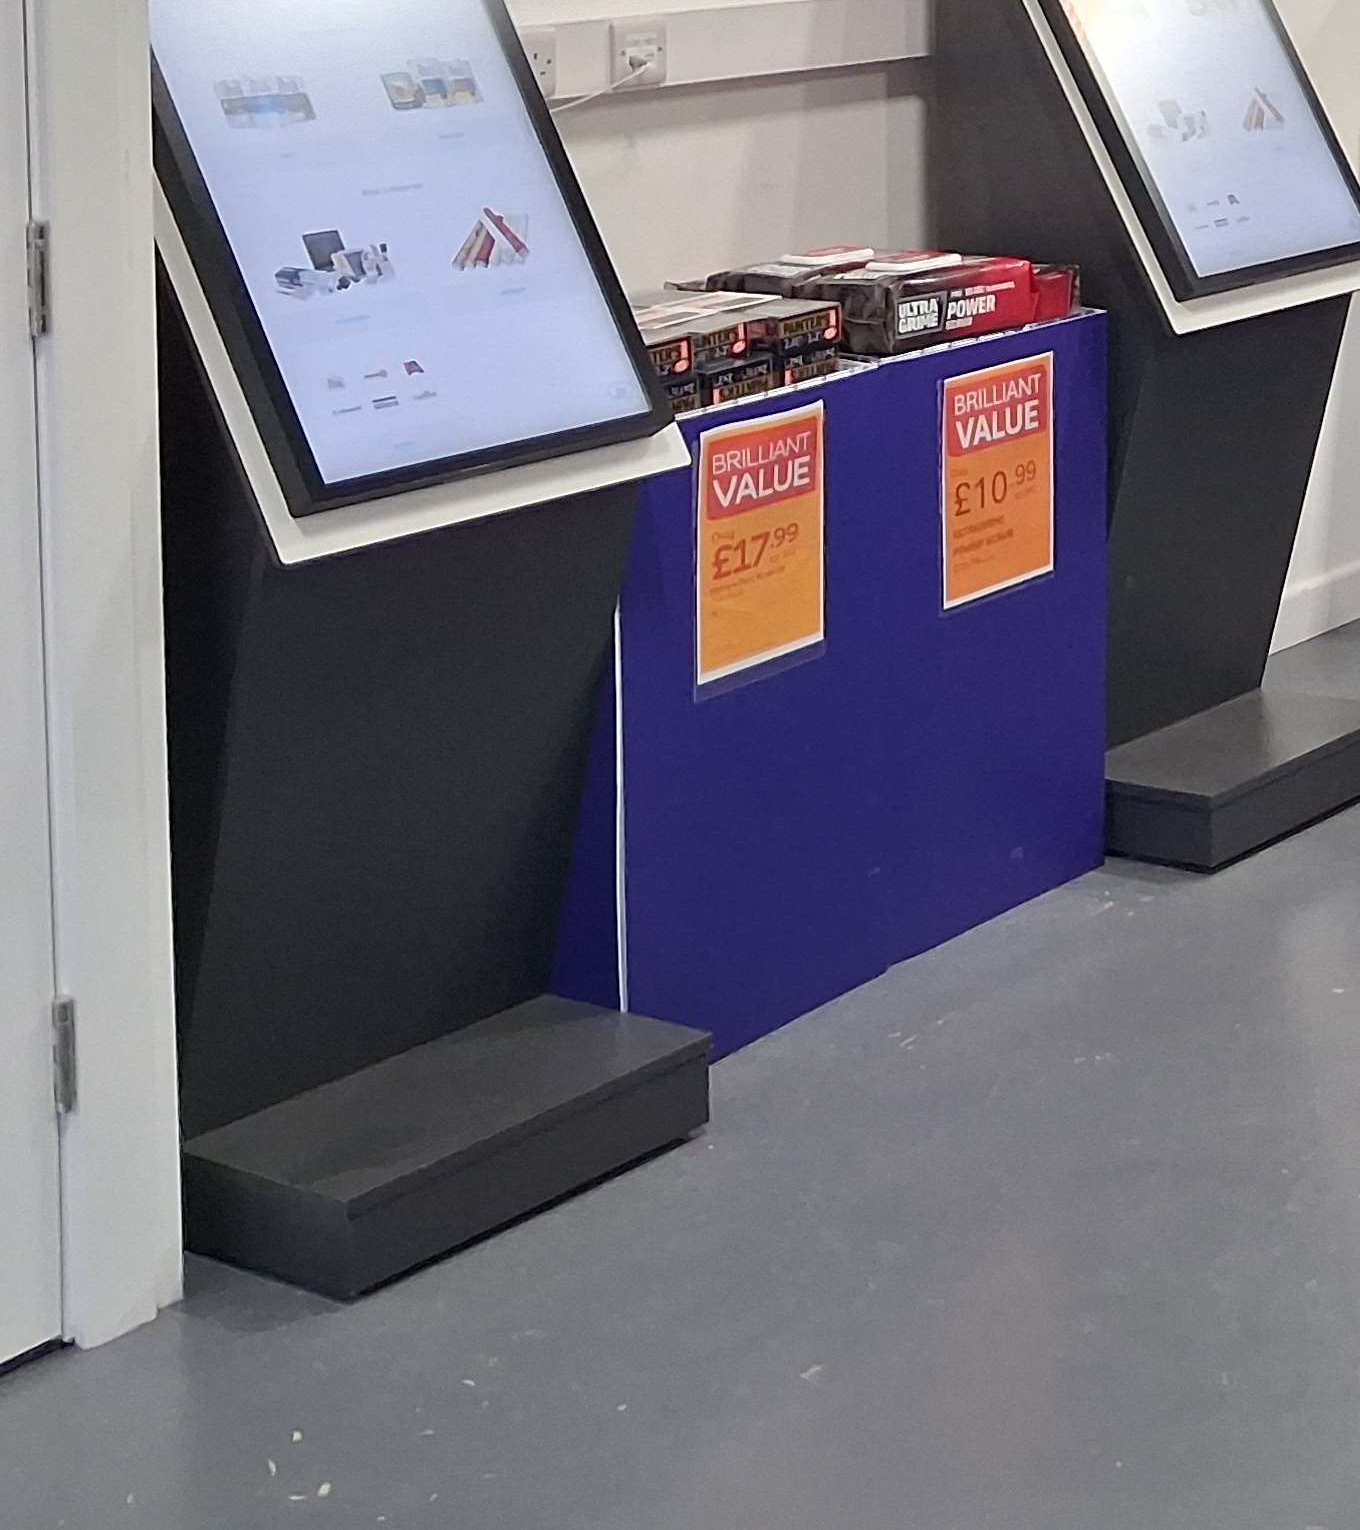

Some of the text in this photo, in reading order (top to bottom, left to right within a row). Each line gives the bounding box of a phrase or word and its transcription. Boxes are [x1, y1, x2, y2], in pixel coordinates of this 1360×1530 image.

[897, 298, 939, 318] ULTRA
[946, 294, 997, 320] POWER
[953, 372, 1042, 417] BRILLIANT
[954, 398, 1040, 450] VALUE
[711, 430, 812, 476] BRILLIANT
[711, 454, 811, 508] VALUE
[954, 459, 1037, 517] £10.99
[711, 522, 800, 582] £17.99
